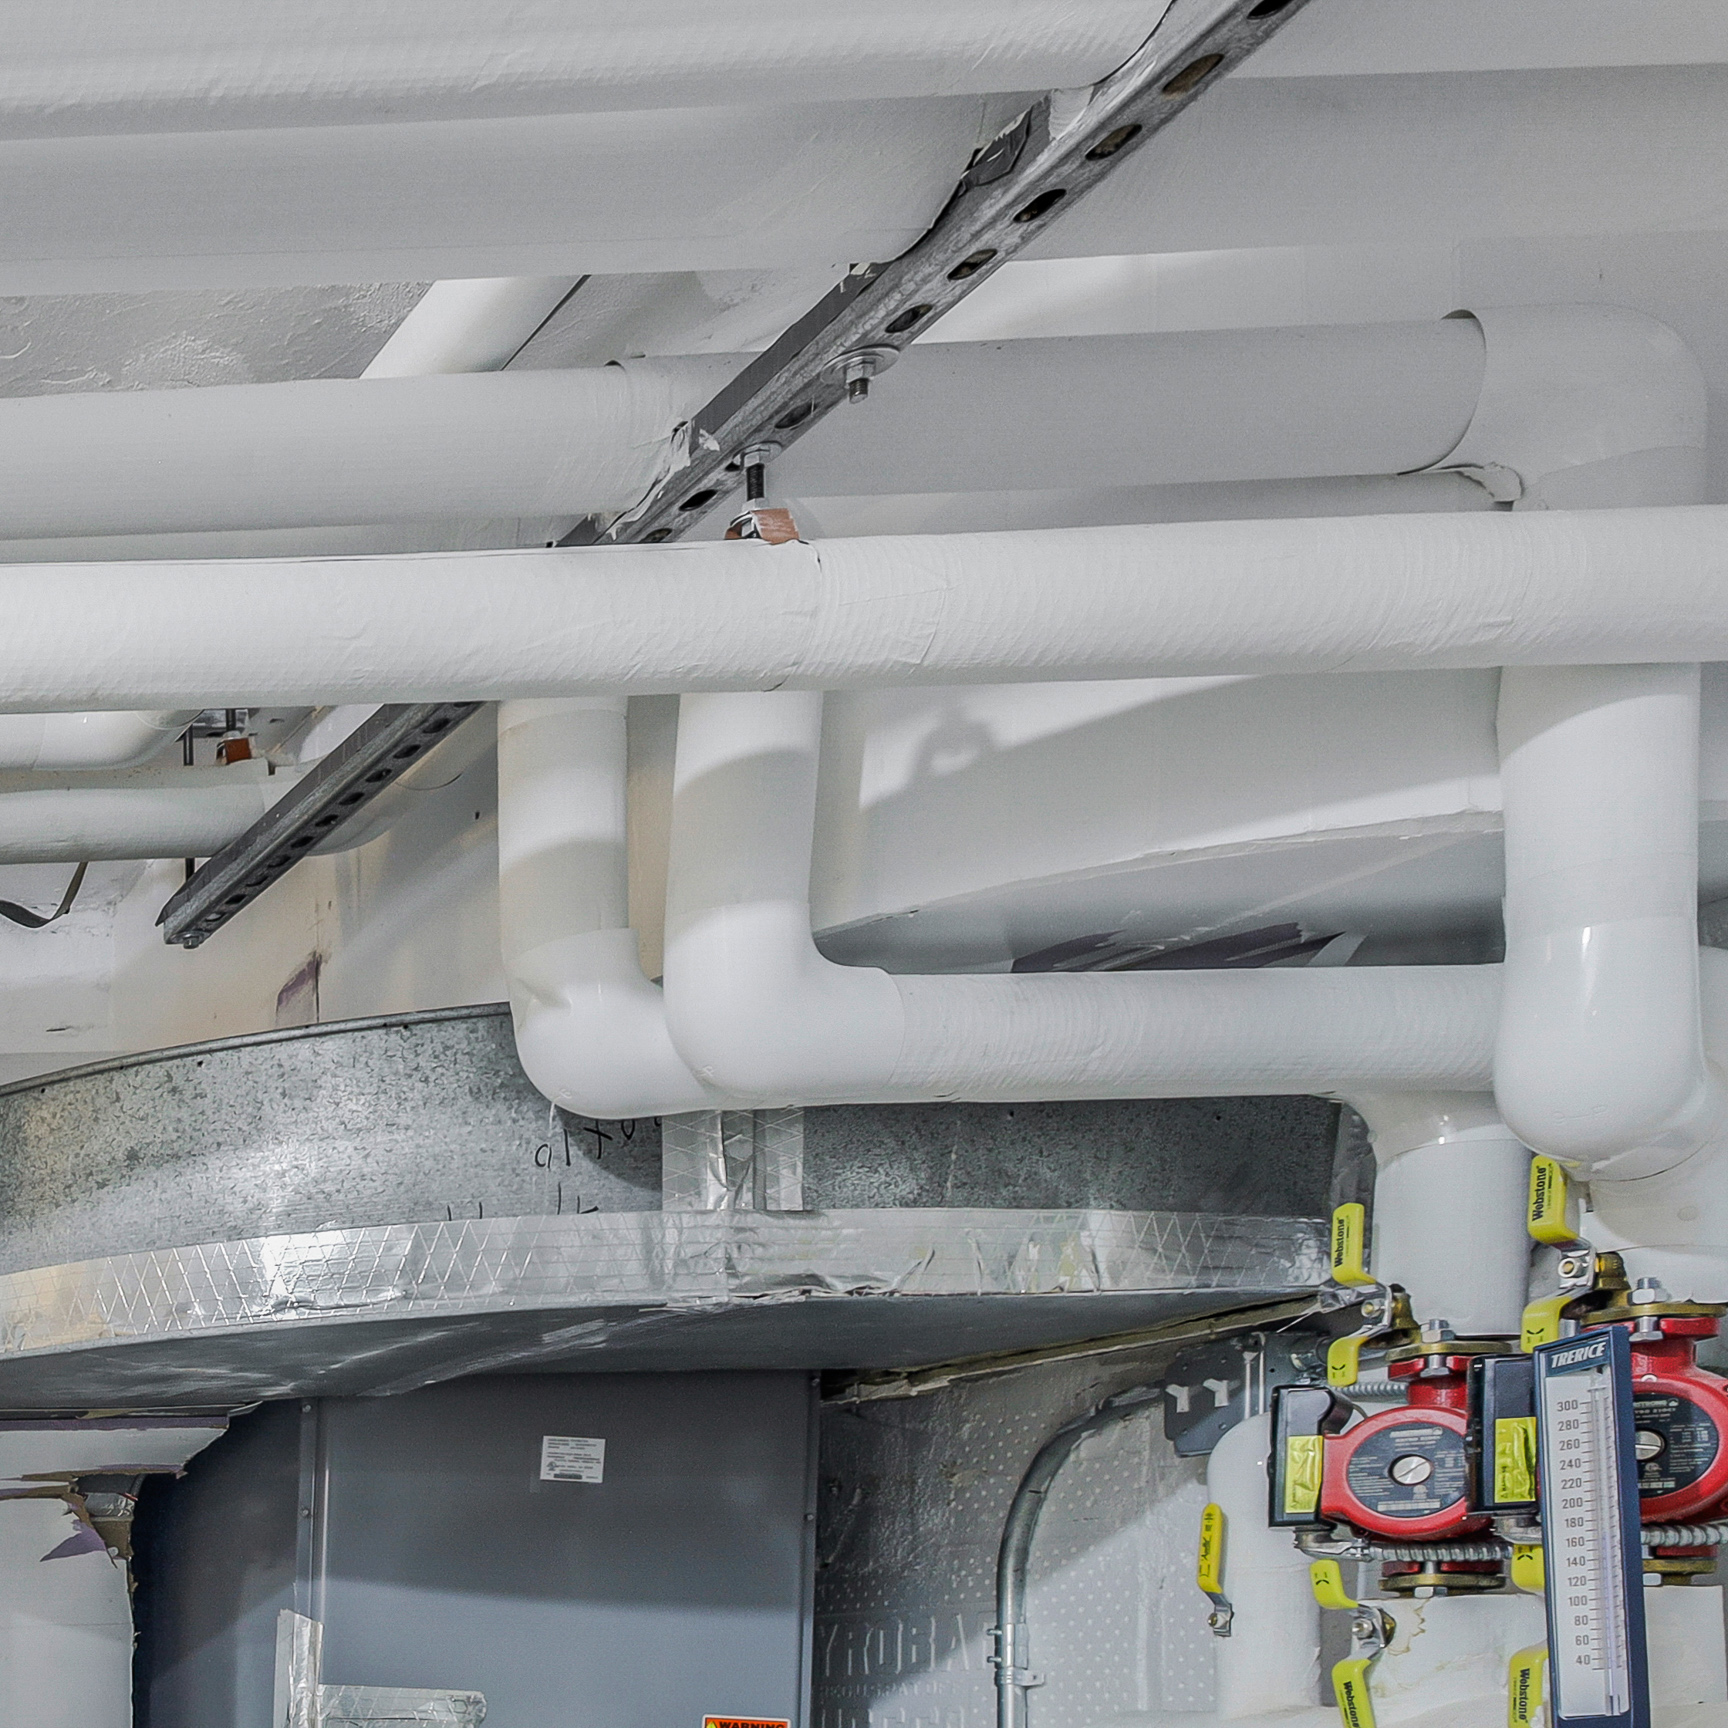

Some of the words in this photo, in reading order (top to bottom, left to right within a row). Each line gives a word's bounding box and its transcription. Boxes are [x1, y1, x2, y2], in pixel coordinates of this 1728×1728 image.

[1531, 1165, 1547, 1222] Webstone
[1334, 1217, 1345, 1268] Webstone
[1551, 1342, 1607, 1369] TRERICE
[1557, 1399, 1578, 1411] 300
[1558, 1418, 1579, 1430] 280
[1559, 1438, 1581, 1450] 260
[1559, 1458, 1581, 1469] 240
[1561, 1478, 1582, 1488] 220
[1562, 1497, 1583, 1508] 200
[1564, 1517, 1584, 1528] 180
[1565, 1537, 1585, 1547] 160
[1566, 1557, 1586, 1567] 140
[1568, 1576, 1587, 1586] 120
[1568, 1596, 1587, 1606] 100
[1574, 1615, 1588, 1626] 80
[1575, 1635, 1589, 1646] 60
[1576, 1654, 1590, 1665] 40
[1519, 1668, 1531, 1723] Webstone
